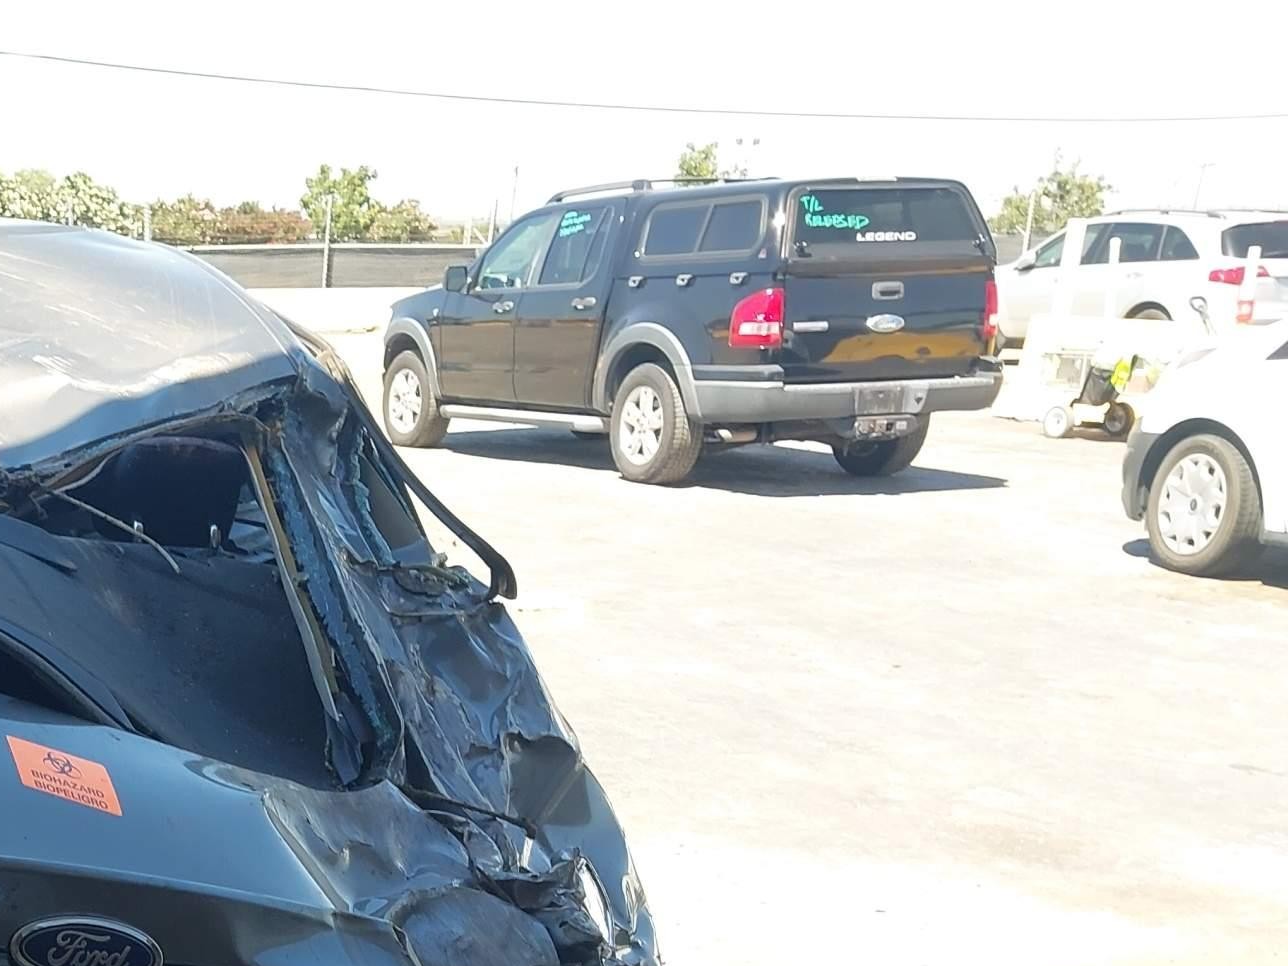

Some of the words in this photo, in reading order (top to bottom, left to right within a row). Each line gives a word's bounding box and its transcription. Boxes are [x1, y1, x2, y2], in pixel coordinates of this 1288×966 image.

[800, 195, 824, 212] T/L
[856, 231, 916, 241] LEGEND
[31, 769, 104, 798] BIOHAZARD
[34, 780, 108, 809] BIOPELIGRO
